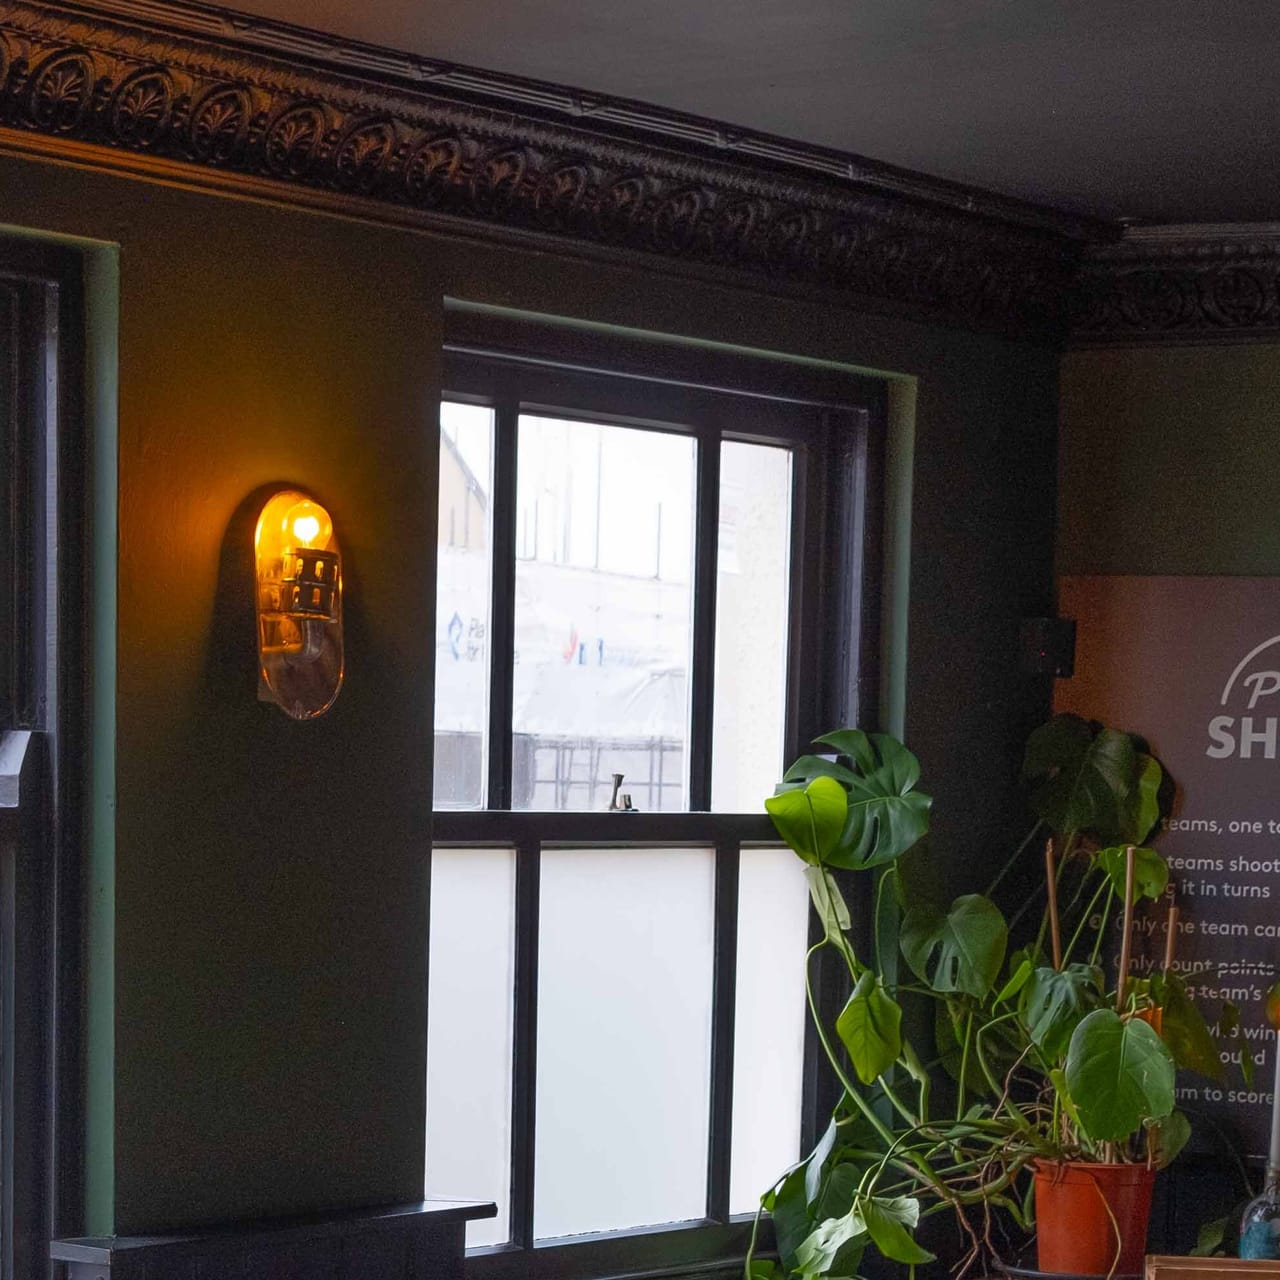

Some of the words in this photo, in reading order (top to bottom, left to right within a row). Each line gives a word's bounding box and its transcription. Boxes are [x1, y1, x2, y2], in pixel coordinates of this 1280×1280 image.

[1229, 818, 1263, 834] one
[1167, 856, 1224, 871] teams
[1229, 856, 1280, 875] shoot
[1182, 880, 1195, 896] it
[1201, 880, 1217, 897] in
[1223, 883, 1270, 899] turns
[1200, 920, 1248, 936] team
[1217, 958, 1275, 978] points
[1244, 1024, 1277, 1041] win
[1204, 1087, 1223, 1102] to
[1227, 1090, 1274, 1105] score
